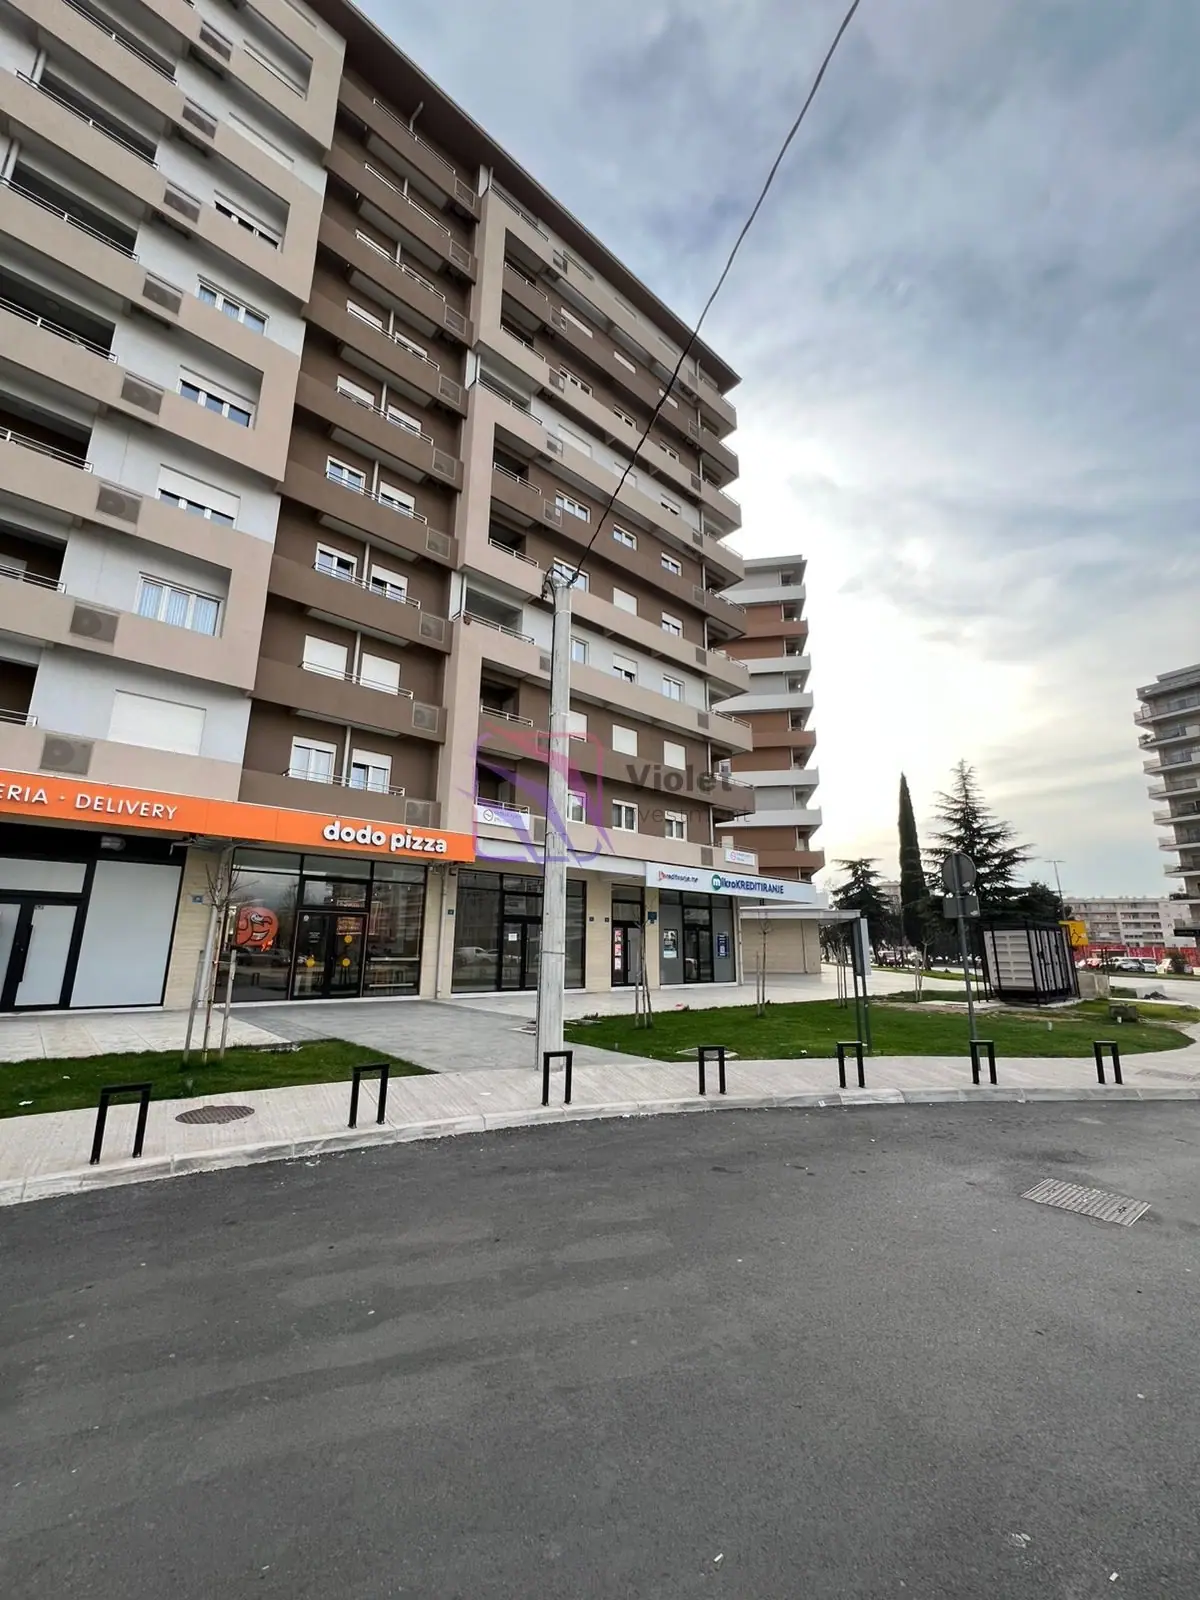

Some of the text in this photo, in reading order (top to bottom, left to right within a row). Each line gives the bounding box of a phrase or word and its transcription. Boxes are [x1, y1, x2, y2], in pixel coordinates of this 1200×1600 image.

[75, 793, 178, 820] DELIVERY
[323, 820, 447, 853] dodo pizza
